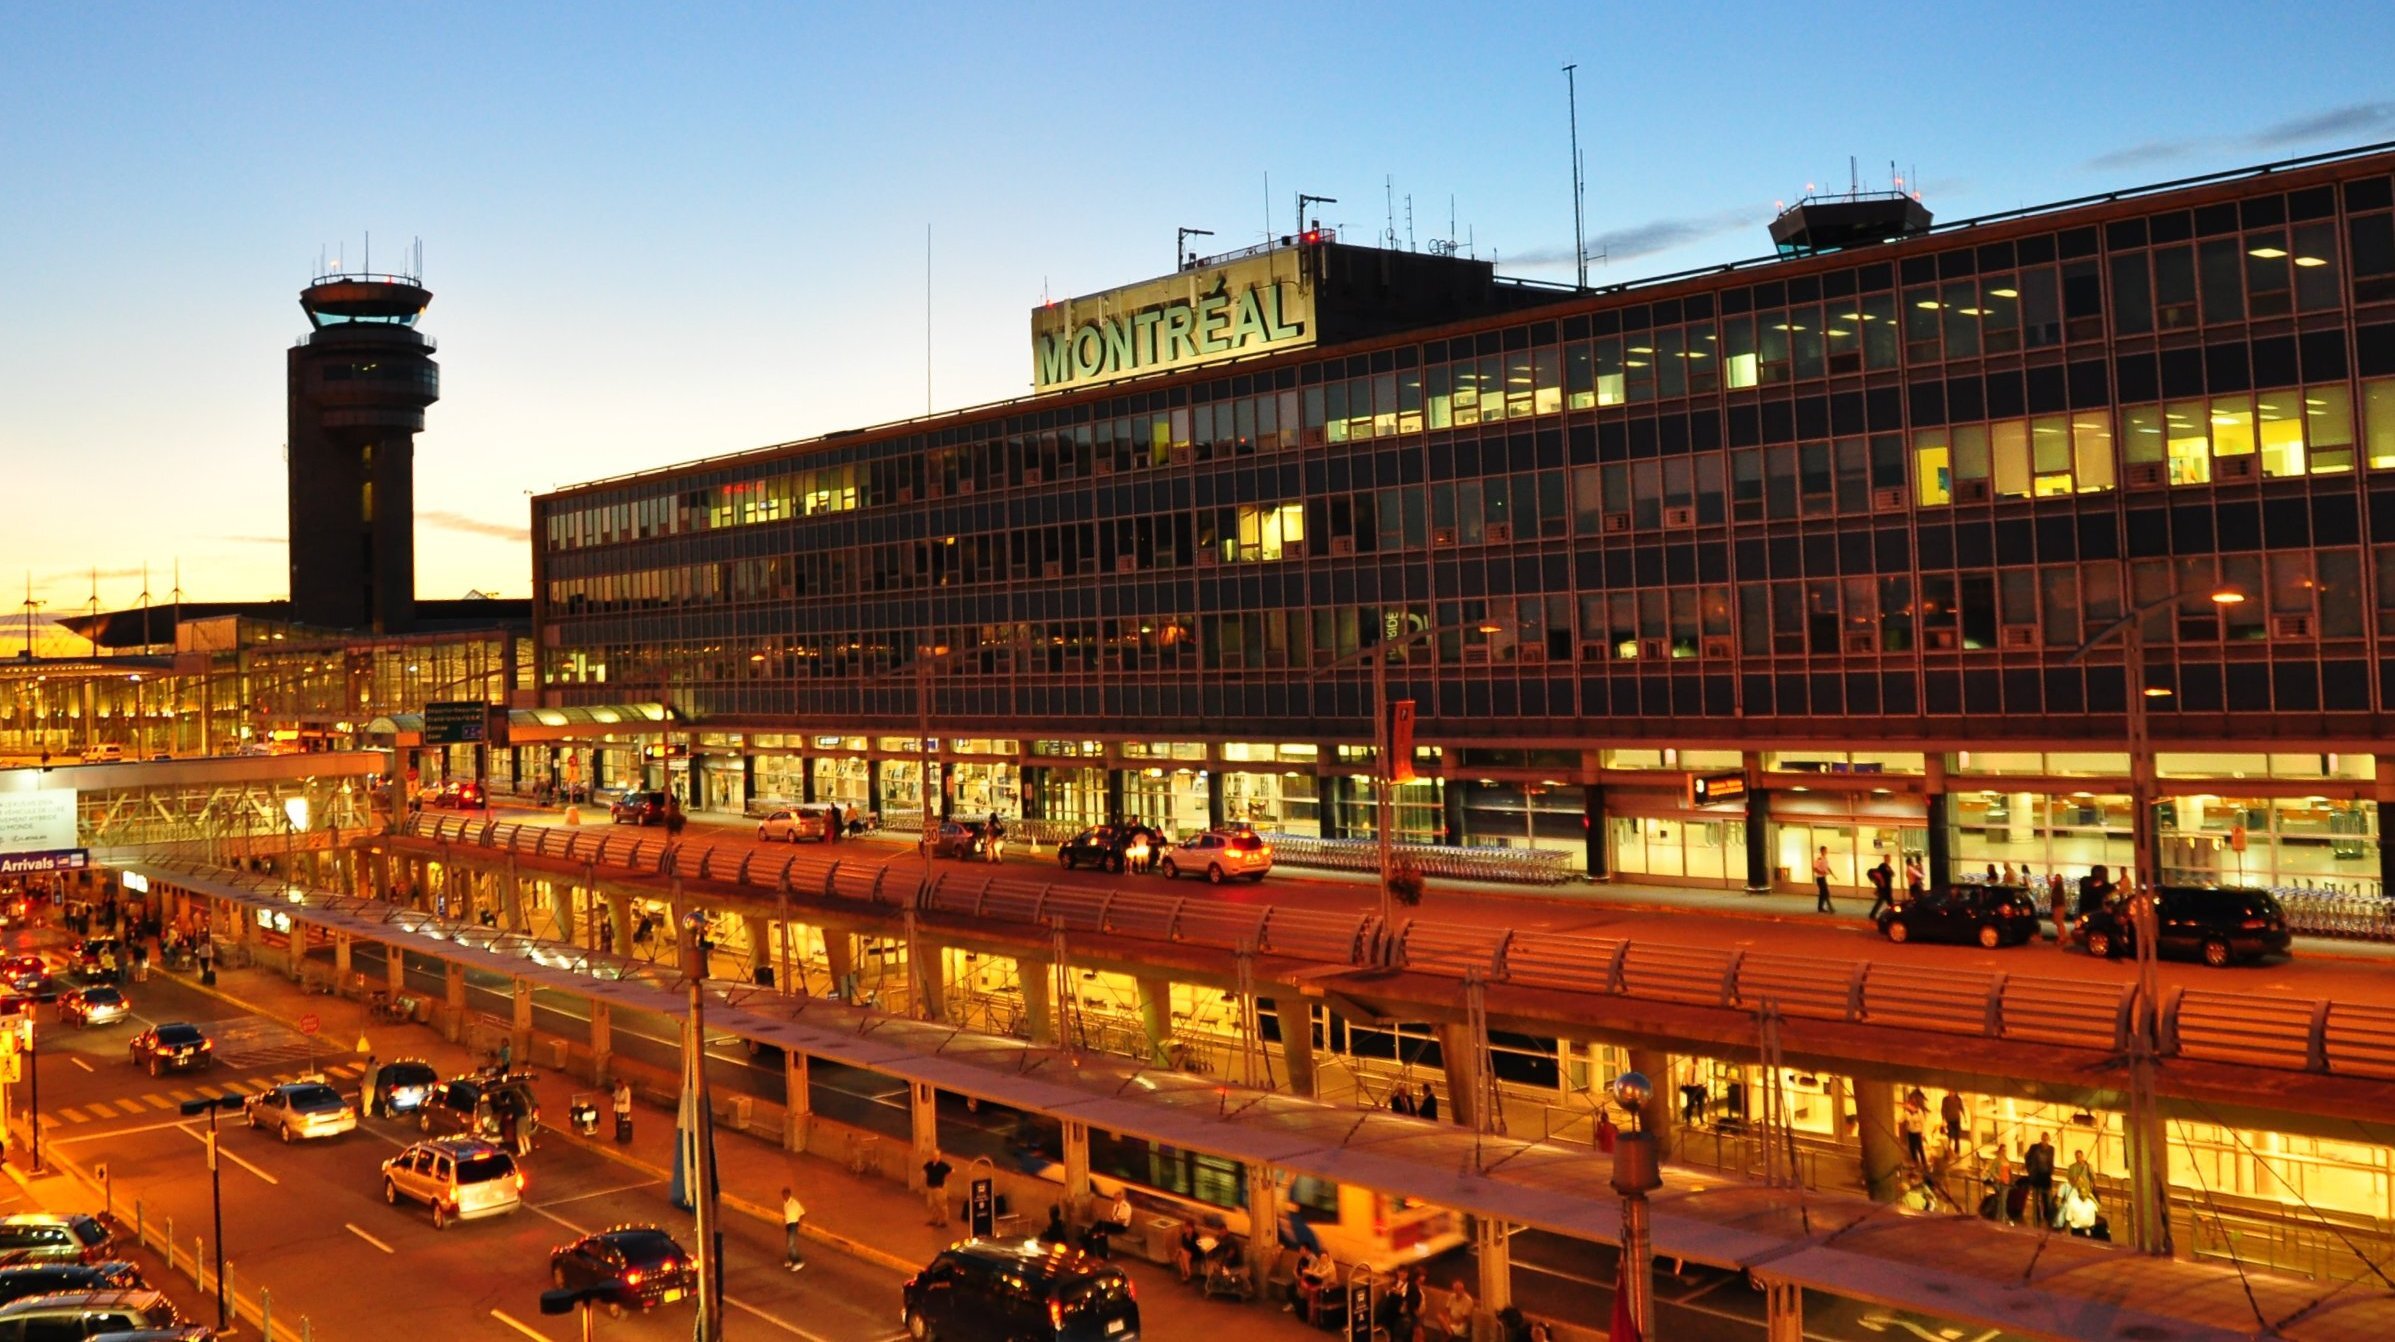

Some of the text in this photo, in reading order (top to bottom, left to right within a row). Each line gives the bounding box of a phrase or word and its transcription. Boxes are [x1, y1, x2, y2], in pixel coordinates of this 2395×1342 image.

[1042, 281, 1299, 384] MONTRÉAL
[925, 829, 937, 842] 30
[2, 857, 54, 872] Arrivals
